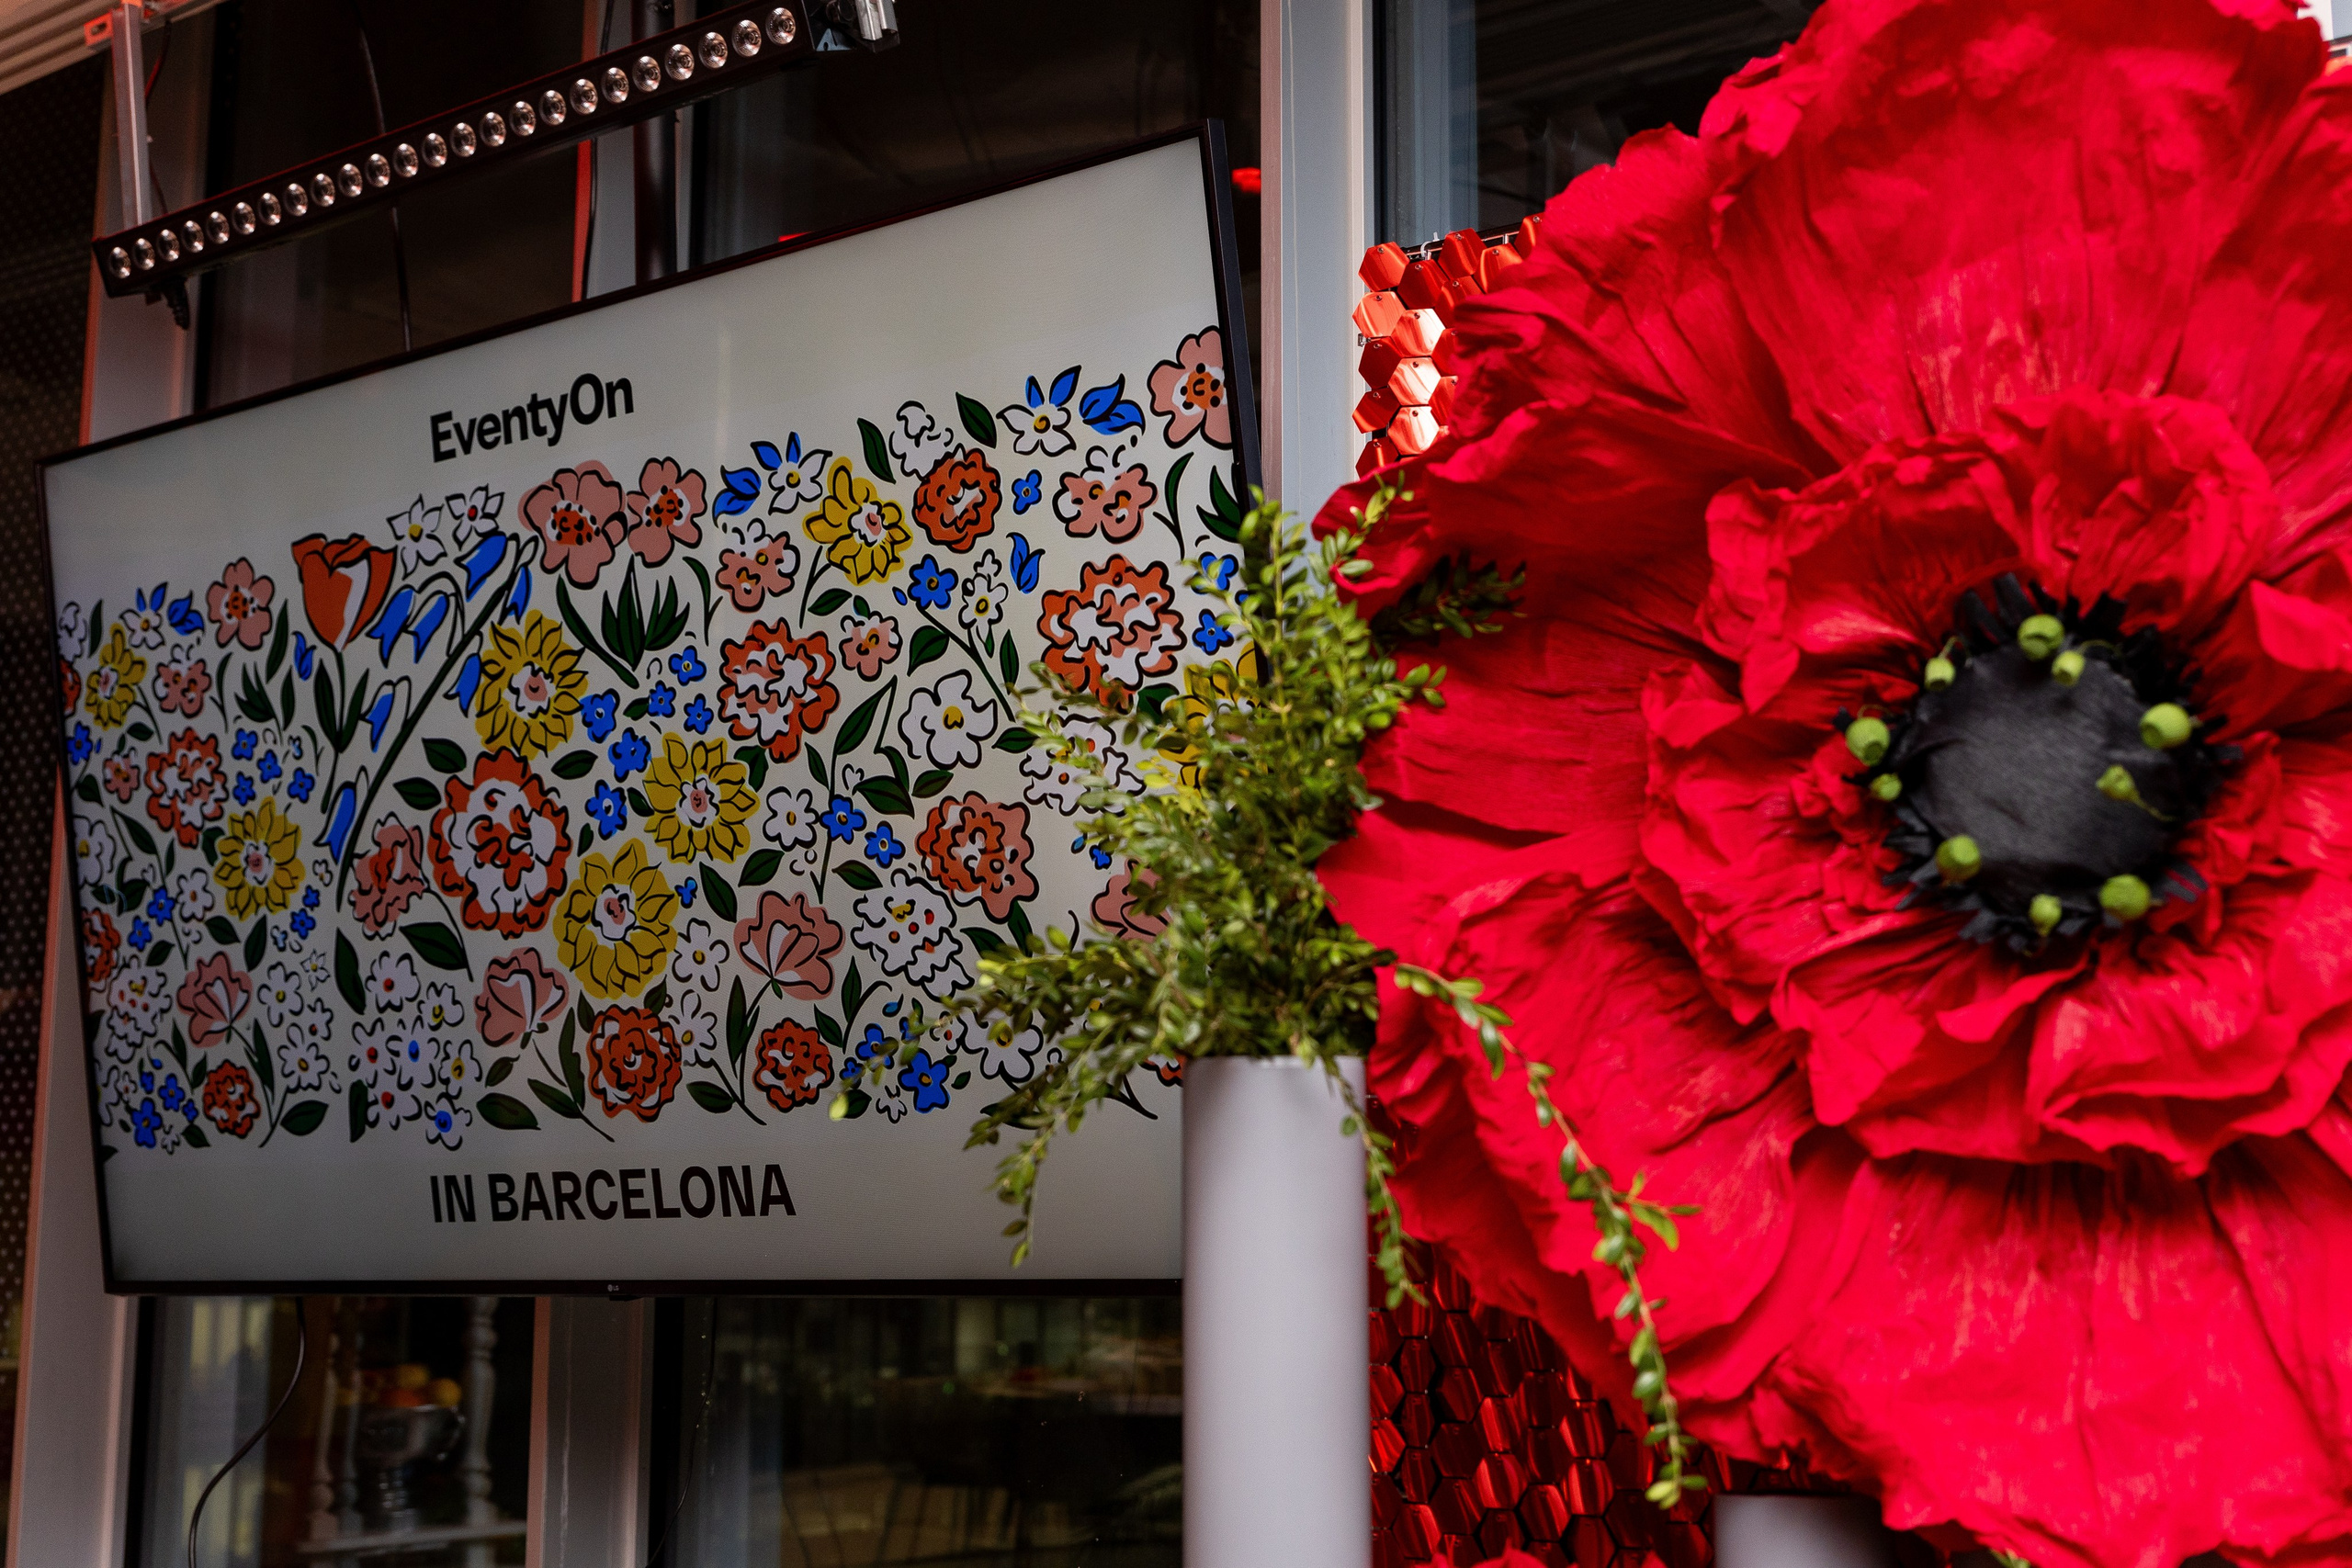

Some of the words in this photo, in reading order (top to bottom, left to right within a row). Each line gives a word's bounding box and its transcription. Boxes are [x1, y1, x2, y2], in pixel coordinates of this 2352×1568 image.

[430, 373, 635, 463] EventyOn
[430, 1174, 477, 1224] IN
[488, 1164, 797, 1222] BARCELONA
